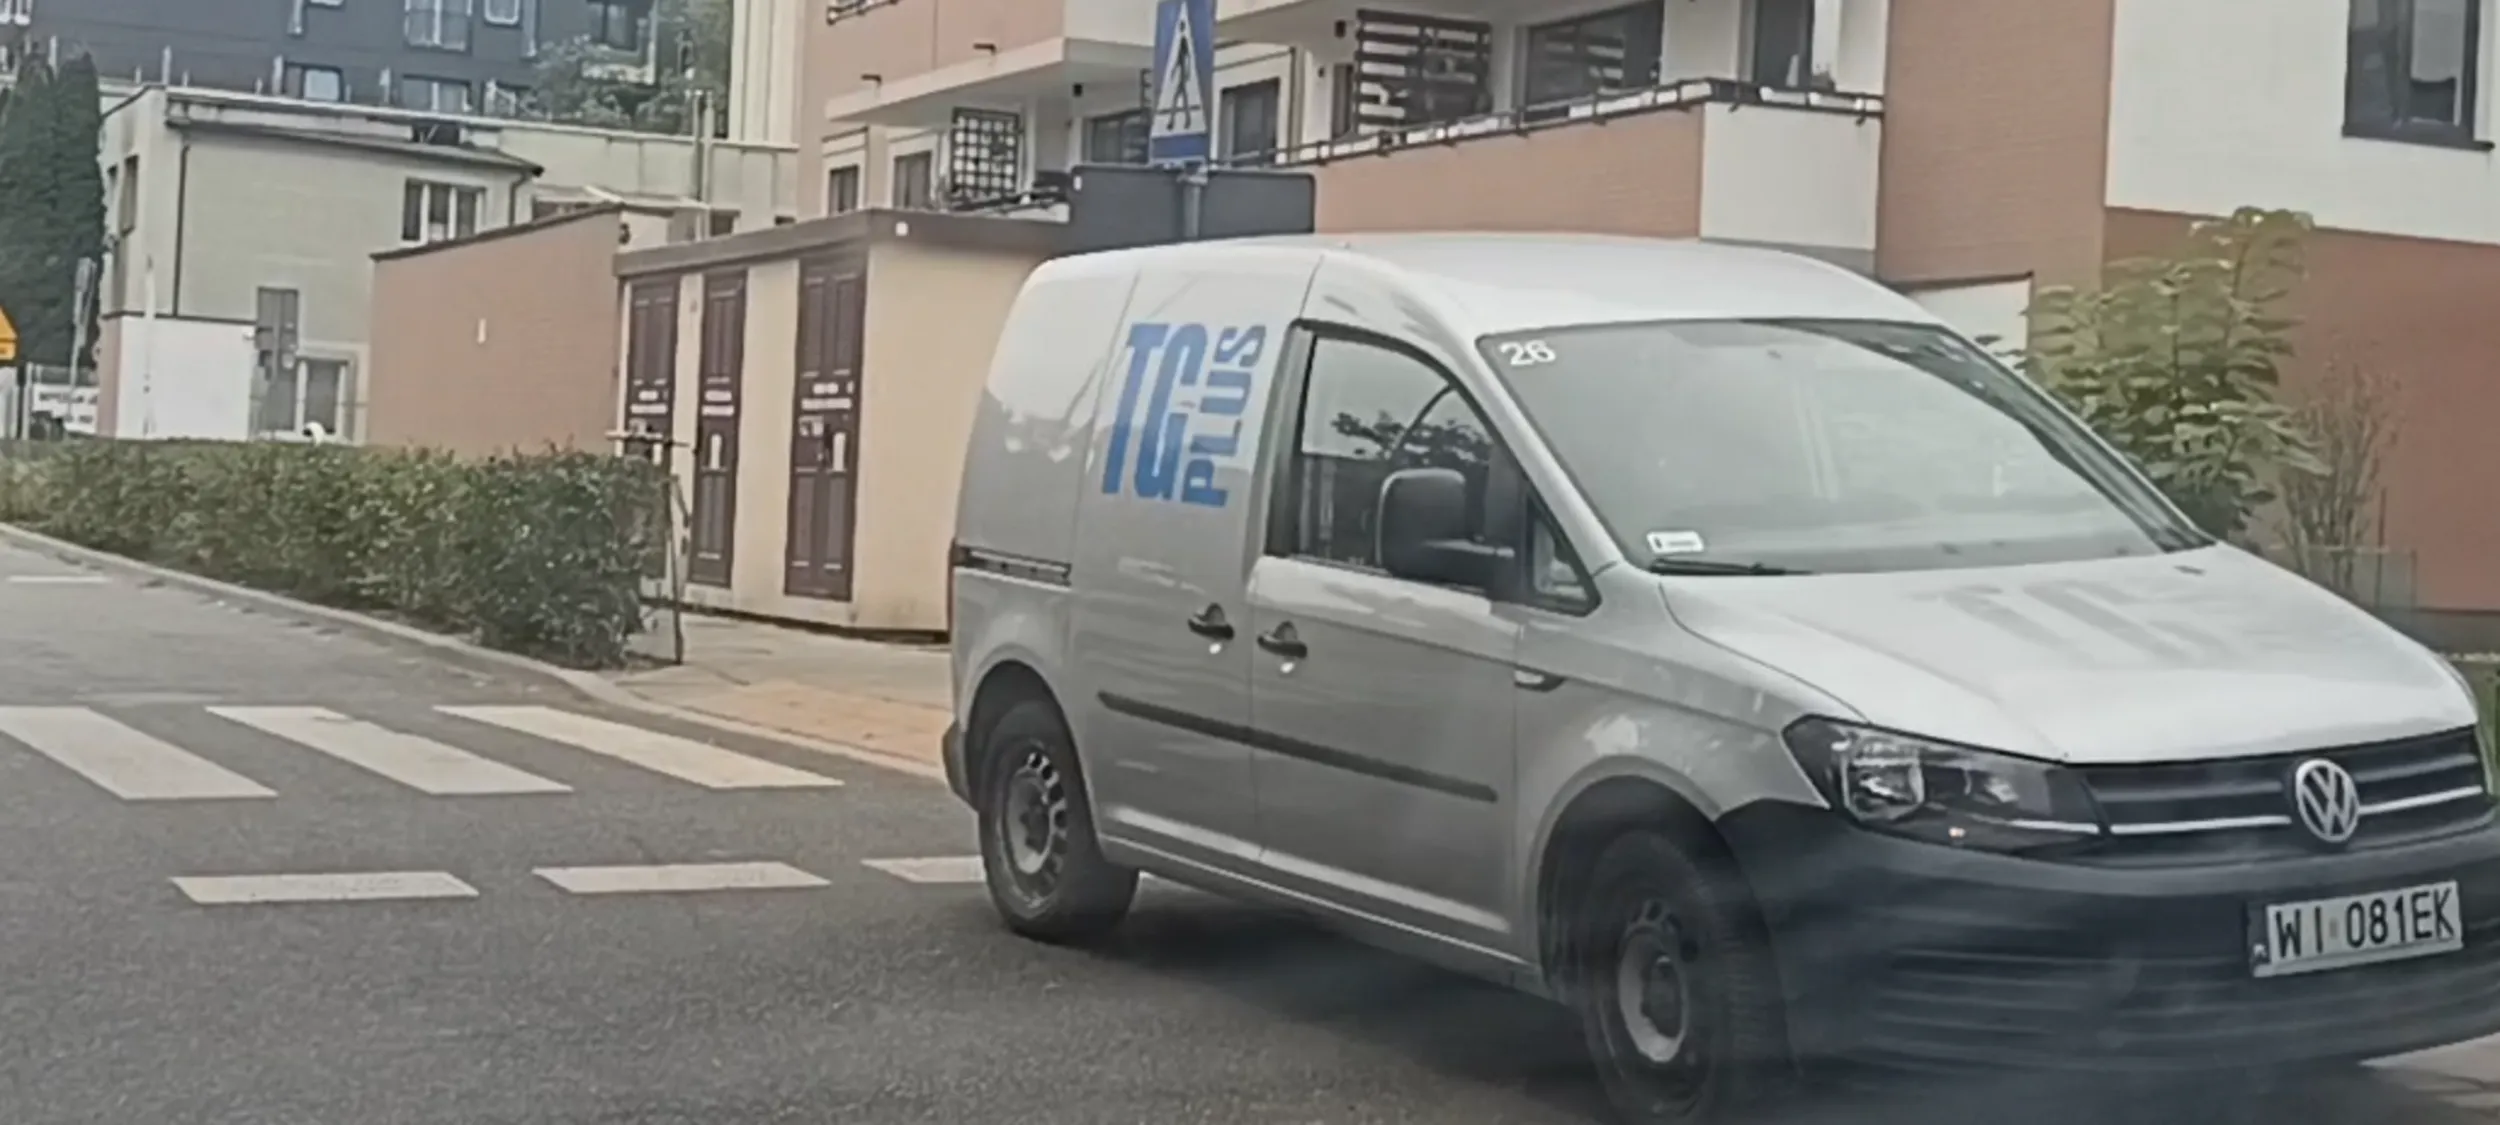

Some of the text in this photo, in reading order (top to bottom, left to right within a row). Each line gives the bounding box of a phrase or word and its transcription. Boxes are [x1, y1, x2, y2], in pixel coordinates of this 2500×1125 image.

[1102, 323, 1208, 500] TG
[1181, 325, 1266, 508] PLUS
[2275, 887, 2455, 958] WI 081EK
